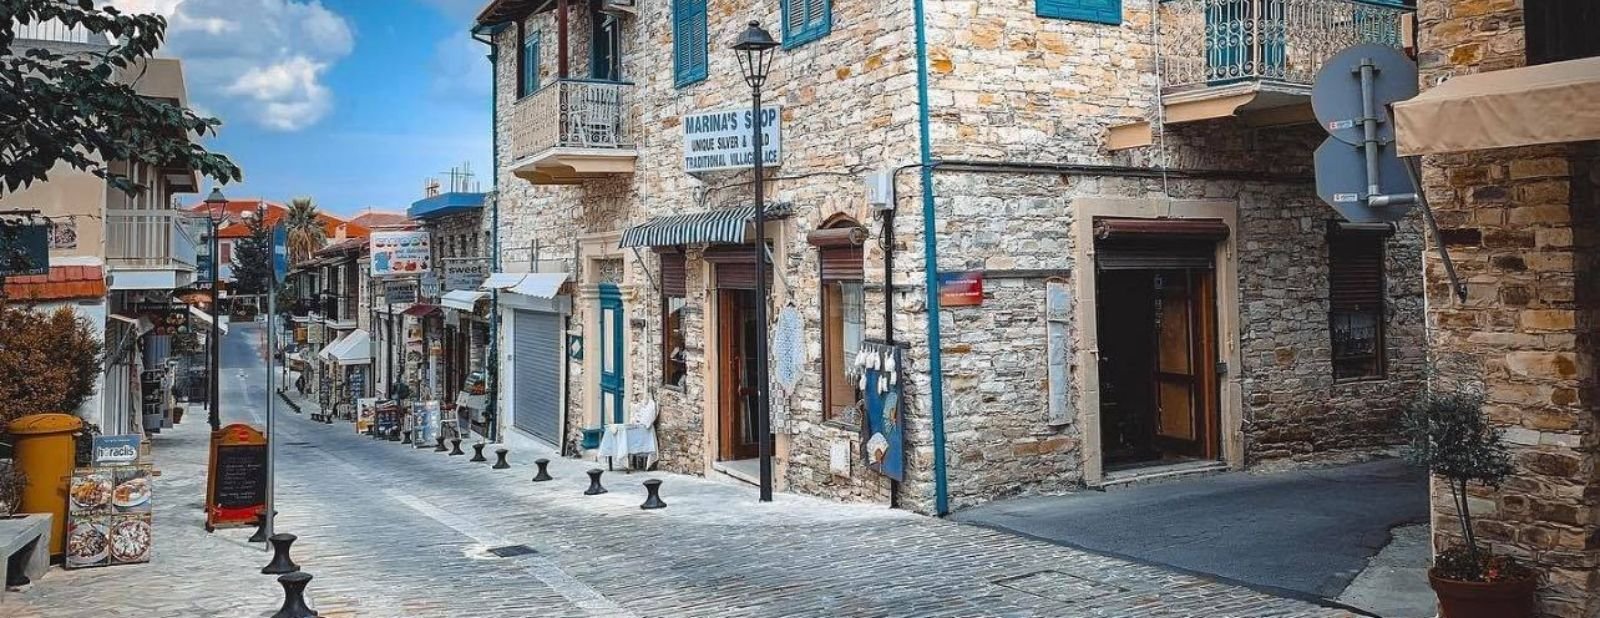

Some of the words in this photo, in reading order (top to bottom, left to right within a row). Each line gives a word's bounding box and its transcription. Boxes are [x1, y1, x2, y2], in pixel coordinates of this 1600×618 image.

[685, 112, 738, 134] MARINA'S
[744, 109, 776, 129] SOP
[691, 138, 715, 152] UNIQUE
[717, 135, 739, 150] SILVER
[685, 153, 727, 169] TRADITIONAL
[448, 264, 482, 274] sweet
